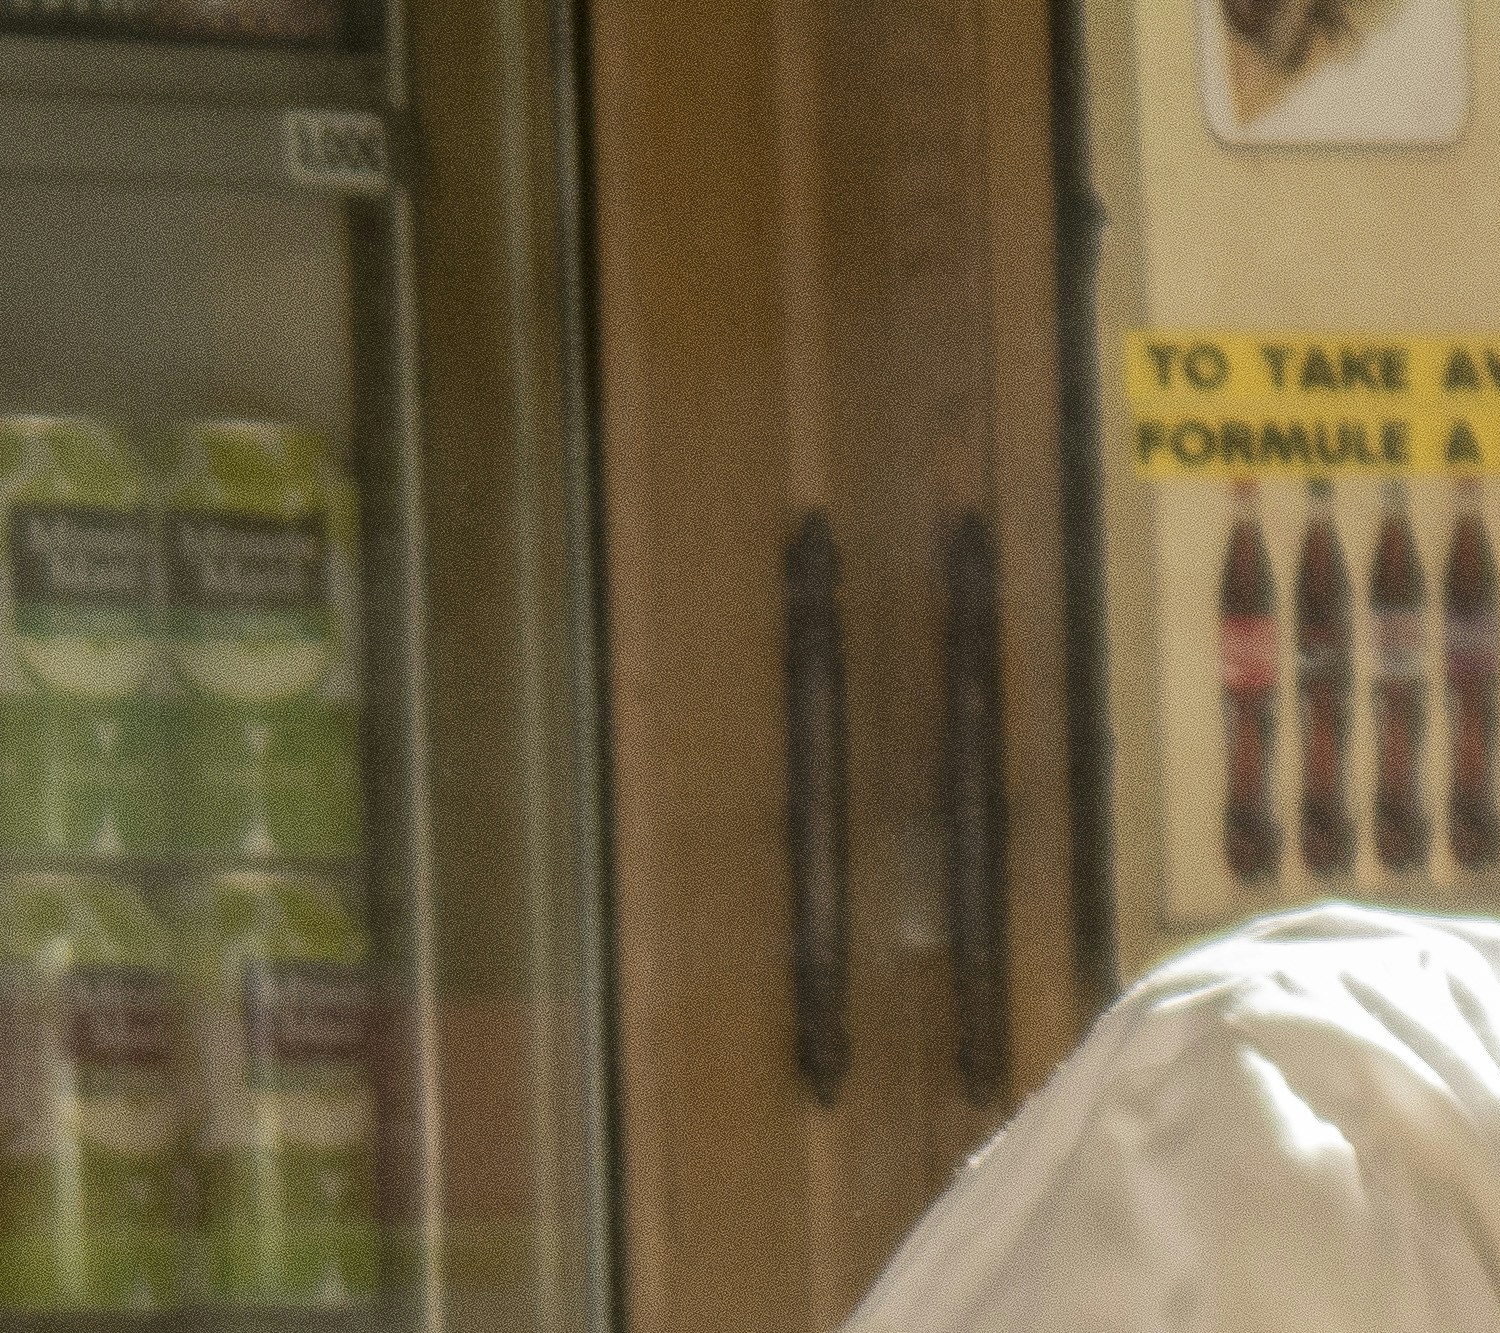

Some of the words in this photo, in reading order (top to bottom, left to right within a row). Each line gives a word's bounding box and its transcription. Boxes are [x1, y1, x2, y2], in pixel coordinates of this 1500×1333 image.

[1146, 344, 1229, 391] TO
[1262, 345, 1410, 392] TAKE
[1135, 418, 1410, 469] FORMULE
[1445, 420, 1481, 465] A
